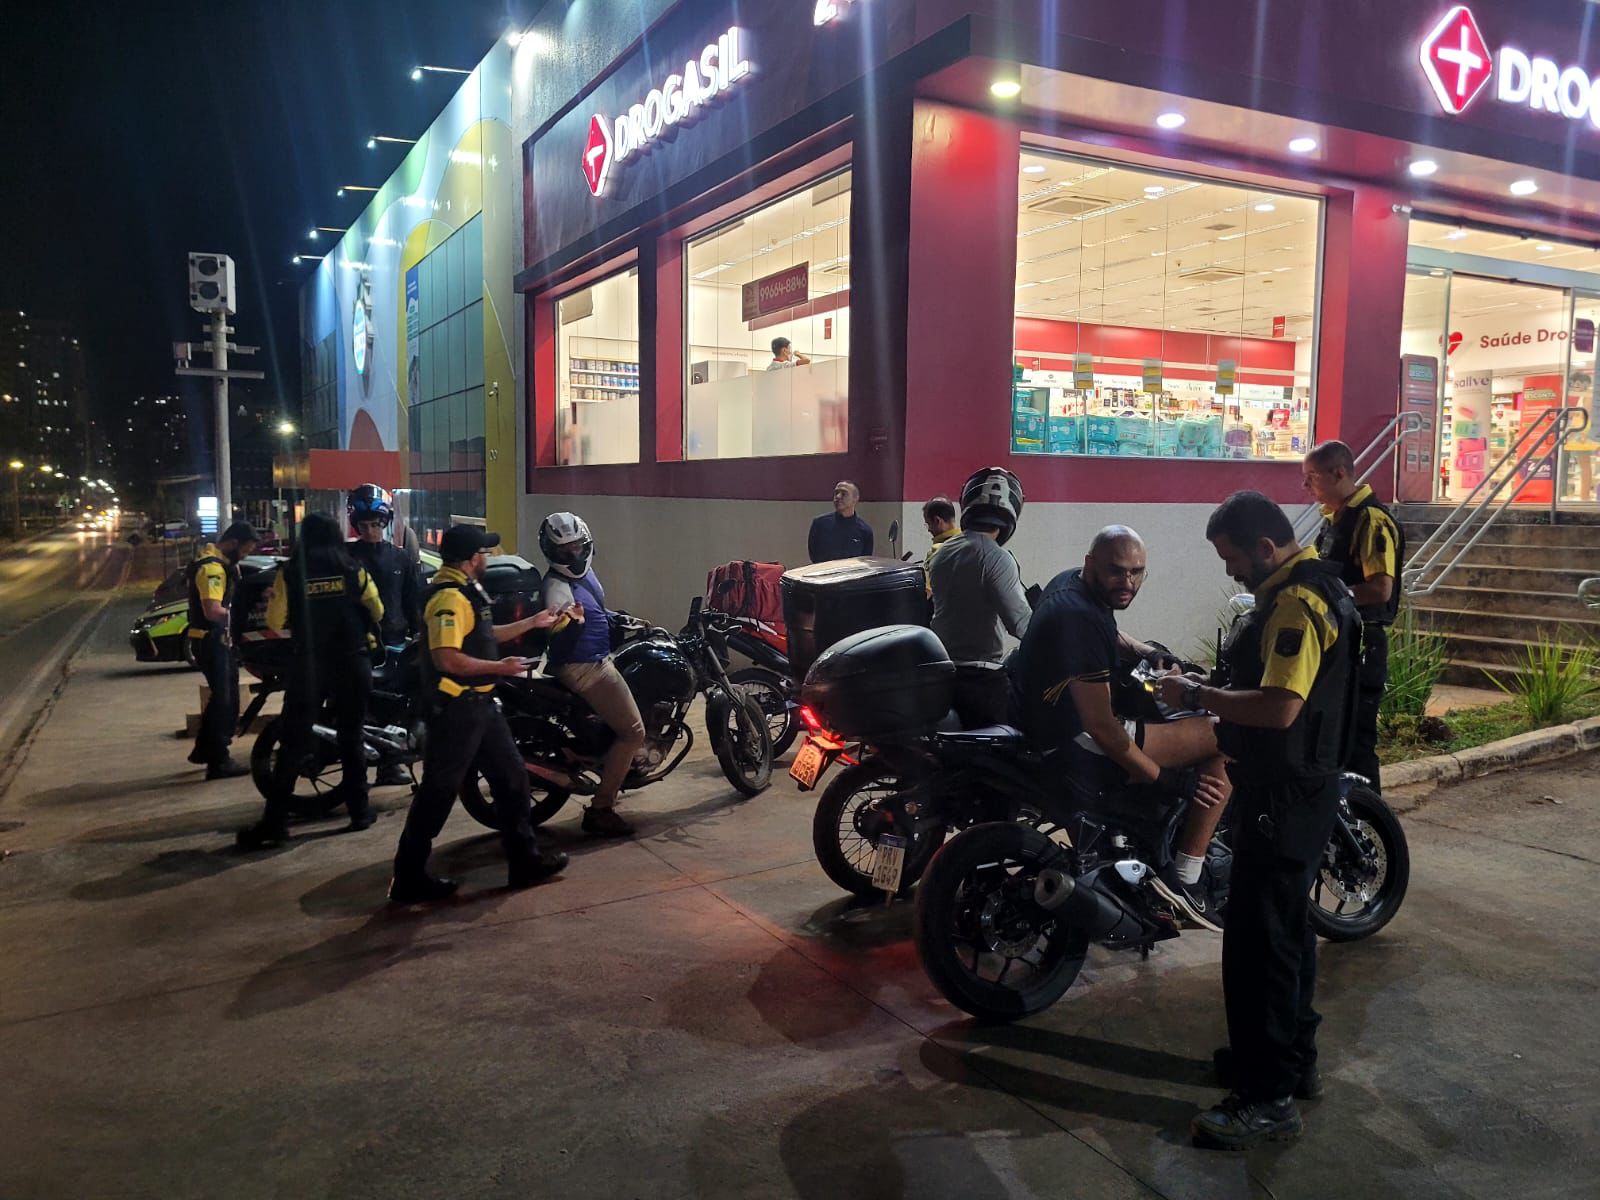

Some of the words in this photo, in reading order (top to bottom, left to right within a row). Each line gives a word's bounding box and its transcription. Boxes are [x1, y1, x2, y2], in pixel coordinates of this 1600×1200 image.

[614, 26, 748, 162] DROGASIL
[1480, 331, 1532, 349] Saúde
[1537, 328, 1575, 344] Dro
[307, 580, 344, 594] DETRAN
